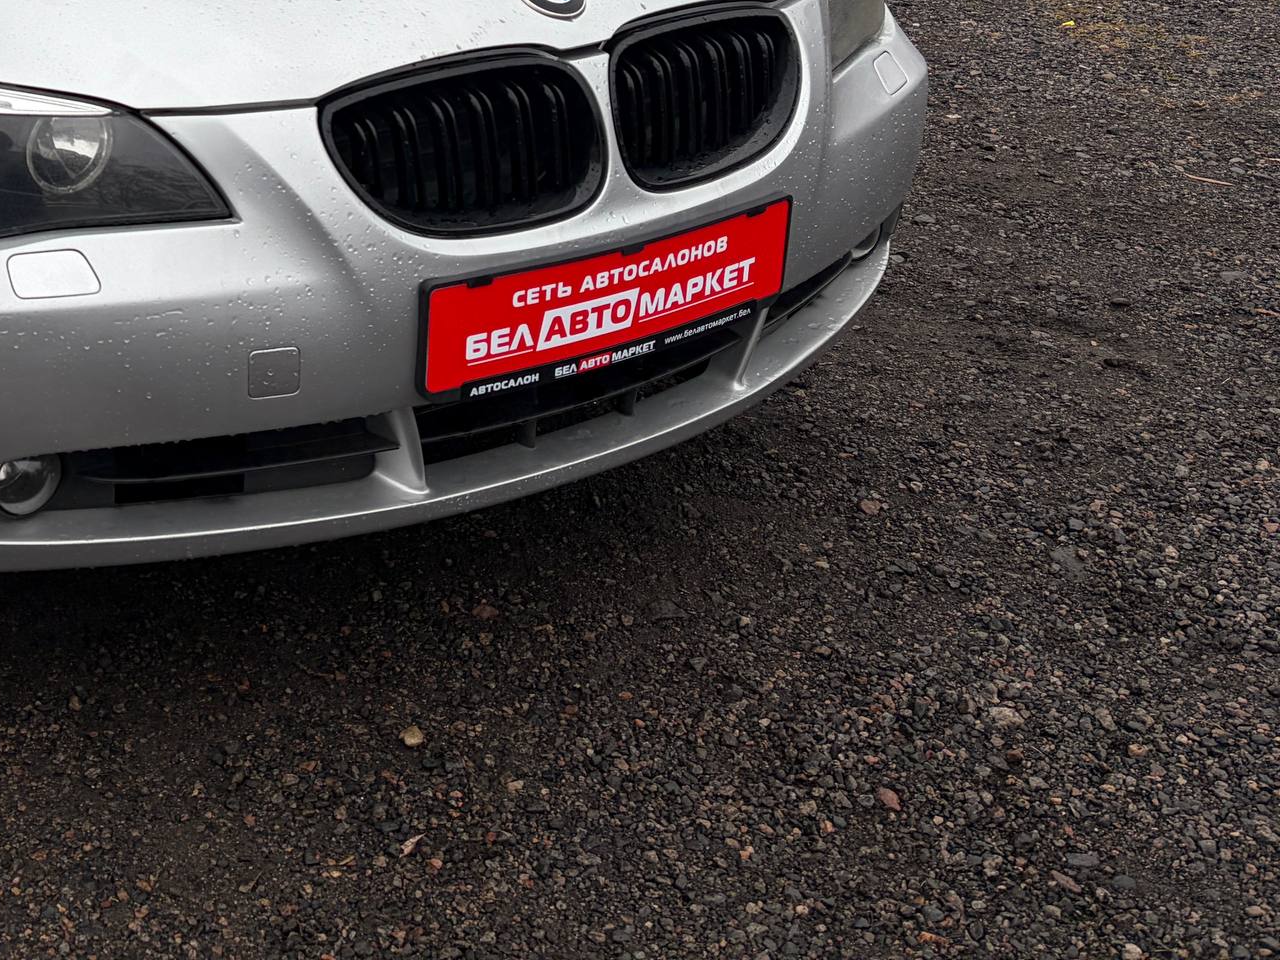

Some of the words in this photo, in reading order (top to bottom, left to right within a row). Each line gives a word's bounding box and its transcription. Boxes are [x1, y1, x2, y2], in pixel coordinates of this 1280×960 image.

[465, 326, 535, 361] БЕЛ
[543, 300, 632, 342] АВТО
[638, 257, 756, 318] МАРКЕТ
[512, 282, 572, 308] СЕТЬ
[579, 235, 728, 294] АВТОСАЛОНОВ
[470, 372, 540, 398] АВТОСАЛОН
[554, 363, 578, 378] БЕЛ
[578, 353, 611, 372] АВТО
[611, 340, 656, 362] МАРКЕТ
[664, 307, 752, 345] www.белавтомаркет.бел
